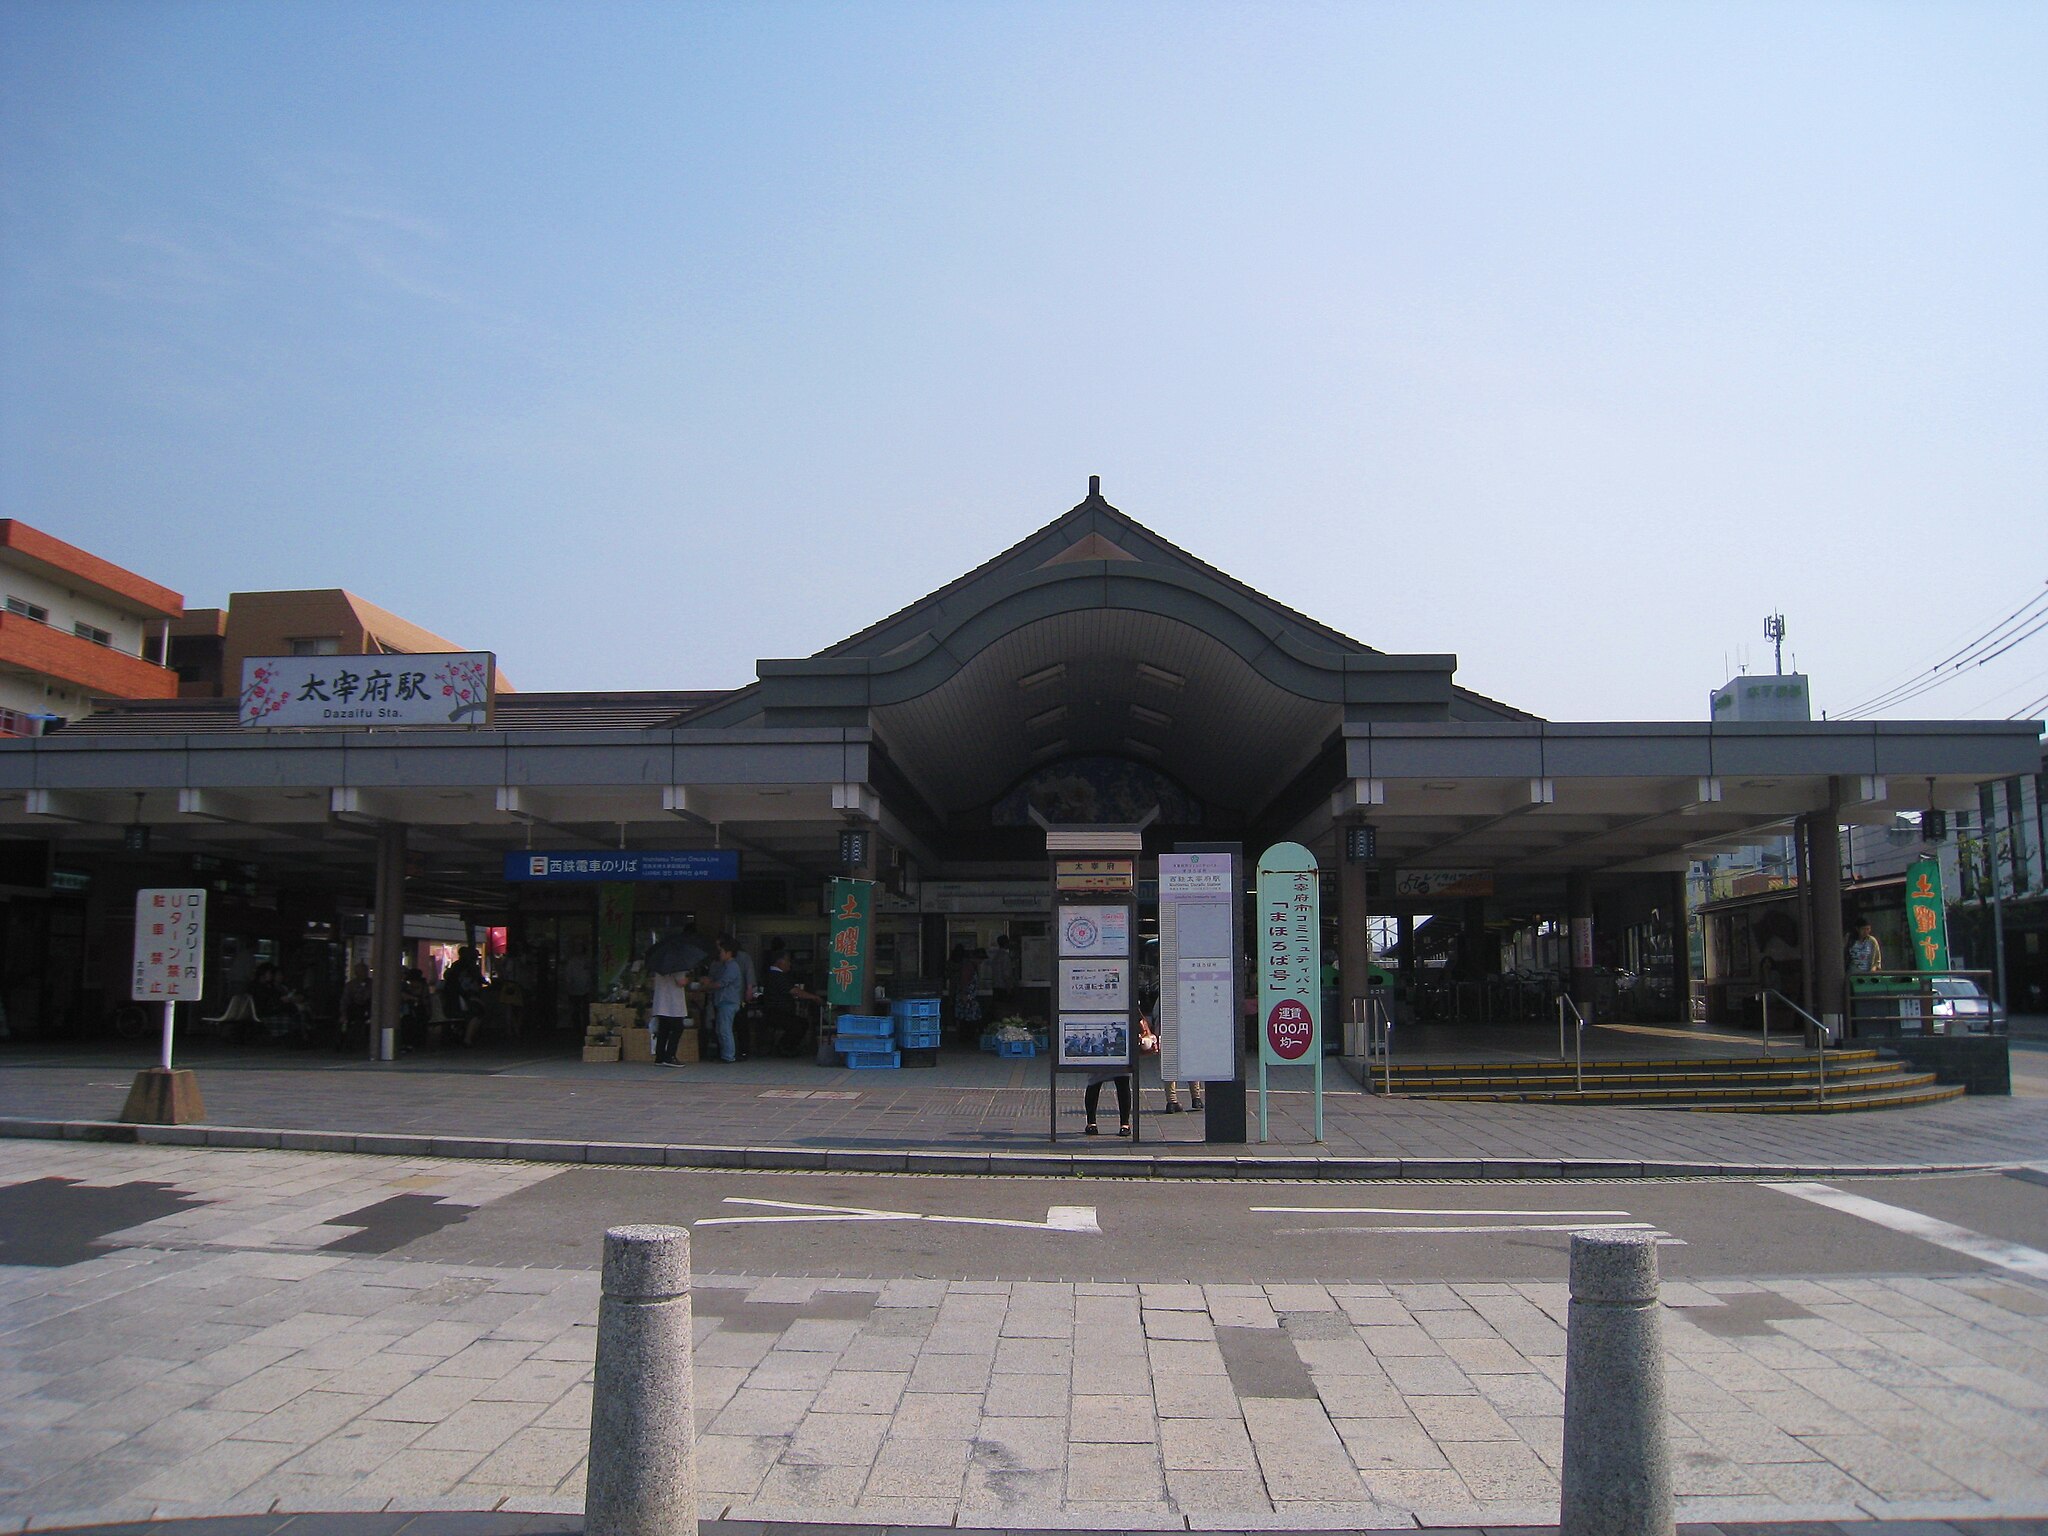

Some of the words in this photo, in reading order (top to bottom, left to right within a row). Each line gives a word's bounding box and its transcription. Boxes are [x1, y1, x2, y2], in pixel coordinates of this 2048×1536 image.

[296, 670, 431, 704] 太宰府駅
[323, 708, 373, 719] Dazaifu
[378, 707, 403, 718] Sta.
[549, 859, 637, 873] 西鉄電車のりば
[1075, 862, 1115, 871] 太宰府
[150, 895, 165, 993] 駐車禁止
[167, 895, 182, 994] Uターン禁止
[184, 894, 200, 978] ロータリー内
[833, 894, 862, 992] 土曜市
[1269, 902, 1291, 991] 「まほろば号」
[1278, 1007, 1302, 1019] 運賃
[1272, 1023, 1309, 1035] 100円
[1279, 1036, 1302, 1048] 均一
